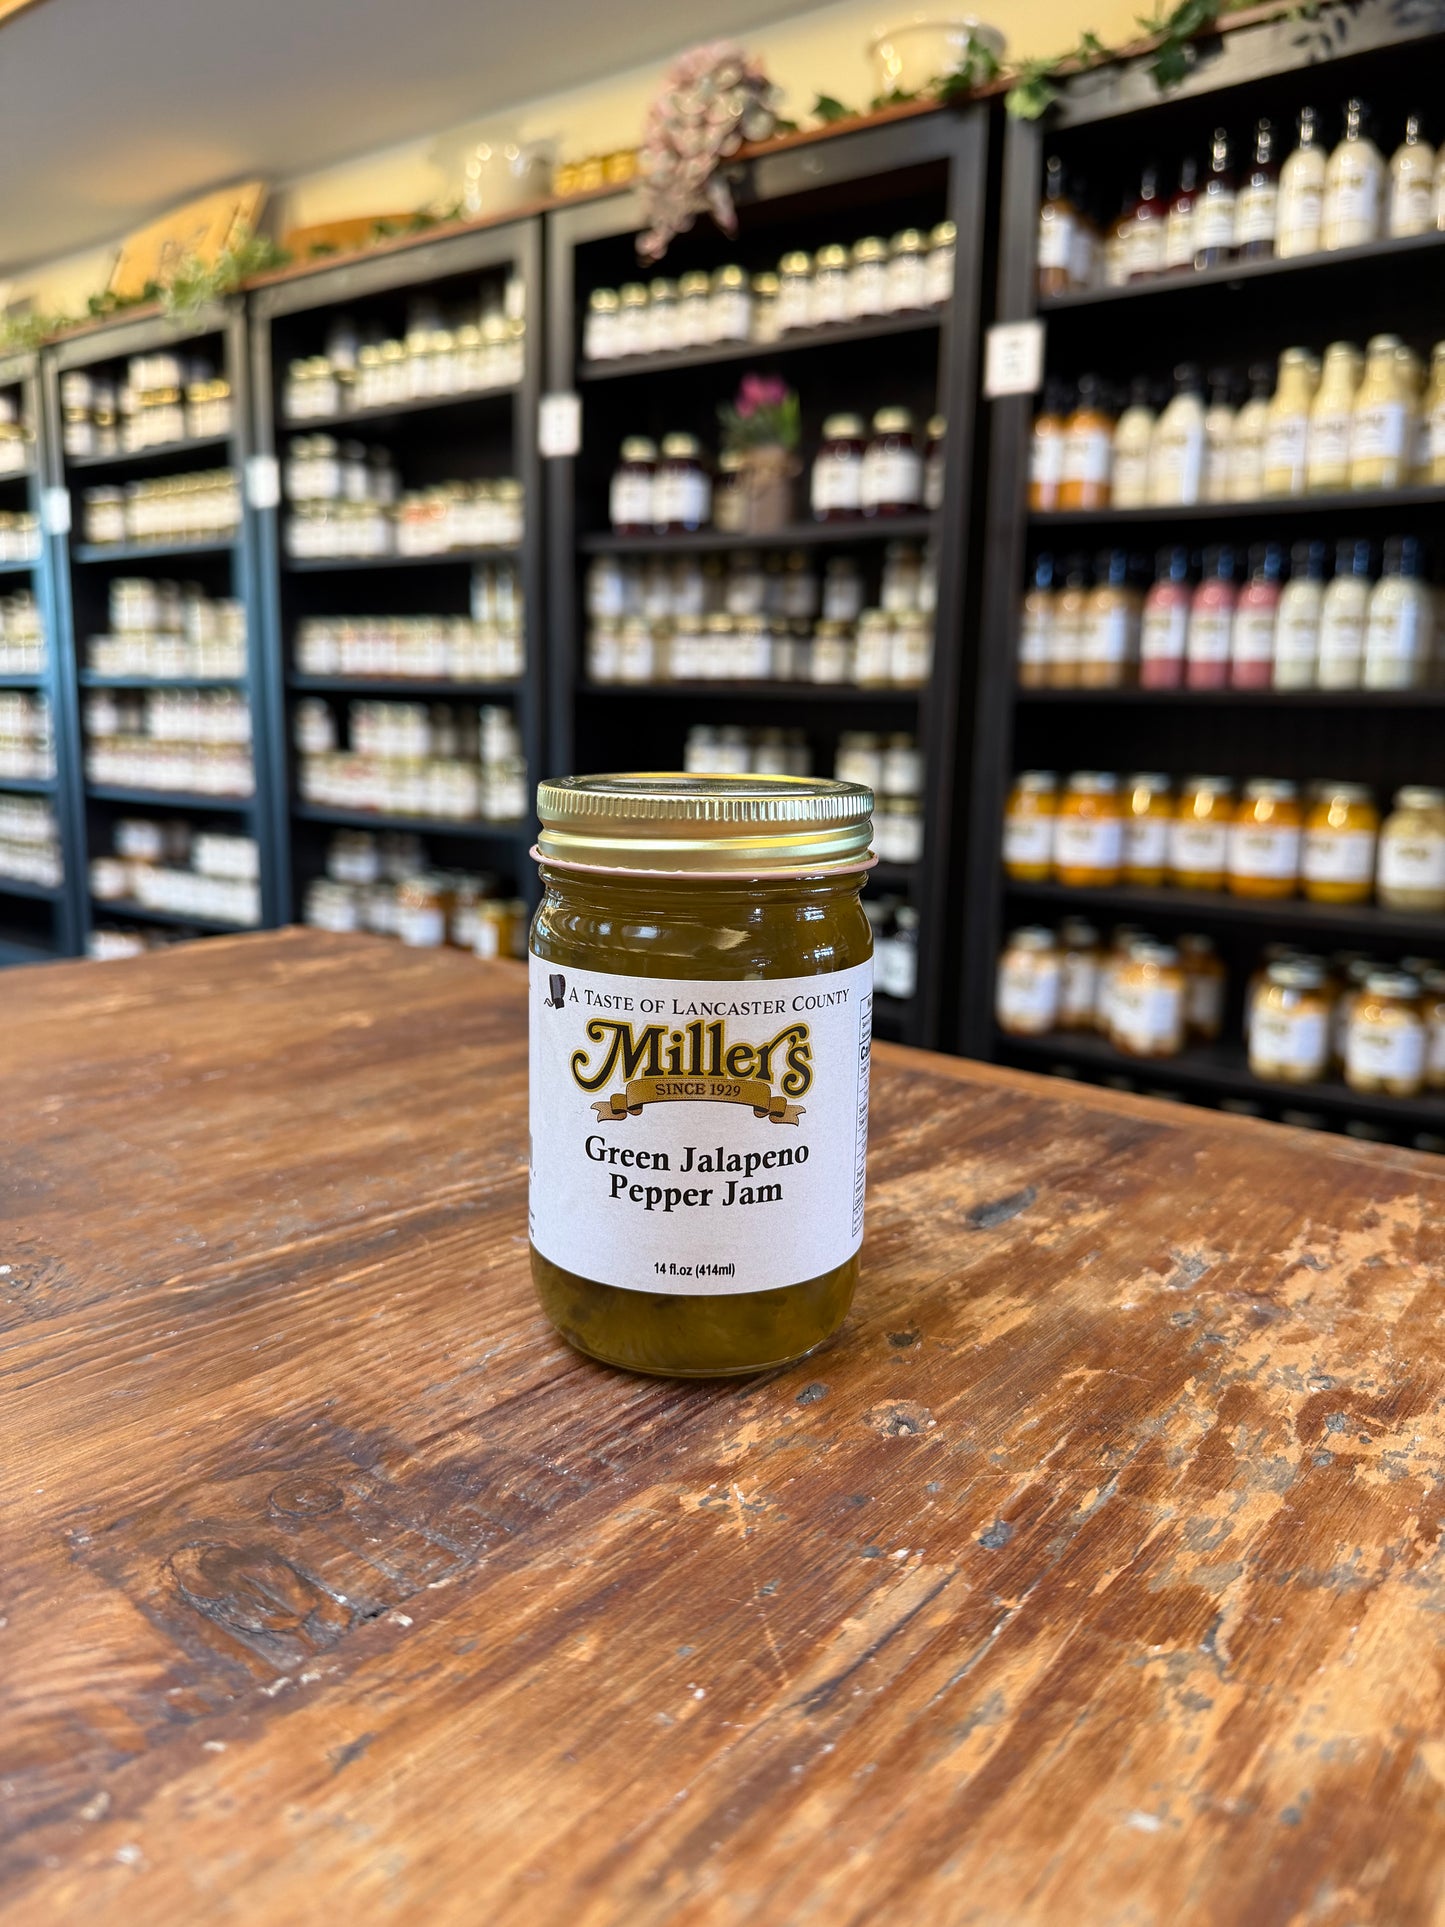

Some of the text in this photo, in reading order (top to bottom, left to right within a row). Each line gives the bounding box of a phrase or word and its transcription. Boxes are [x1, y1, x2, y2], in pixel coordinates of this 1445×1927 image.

[569, 986, 579, 1003] A
[584, 989, 634, 1012] TASTE
[640, 999, 665, 1013] OF
[672, 999, 786, 1016] LANCASTER
[792, 988, 850, 1012] COUNTY
[569, 1018, 813, 1099] Miller's
[655, 1083, 741, 1097] SINCE 1929
[585, 1135, 809, 1179] Green Jalapeno
[609, 1173, 783, 1212] Pepper Jam
[654, 1261, 735, 1279] 14 fl.oz (414ml)
